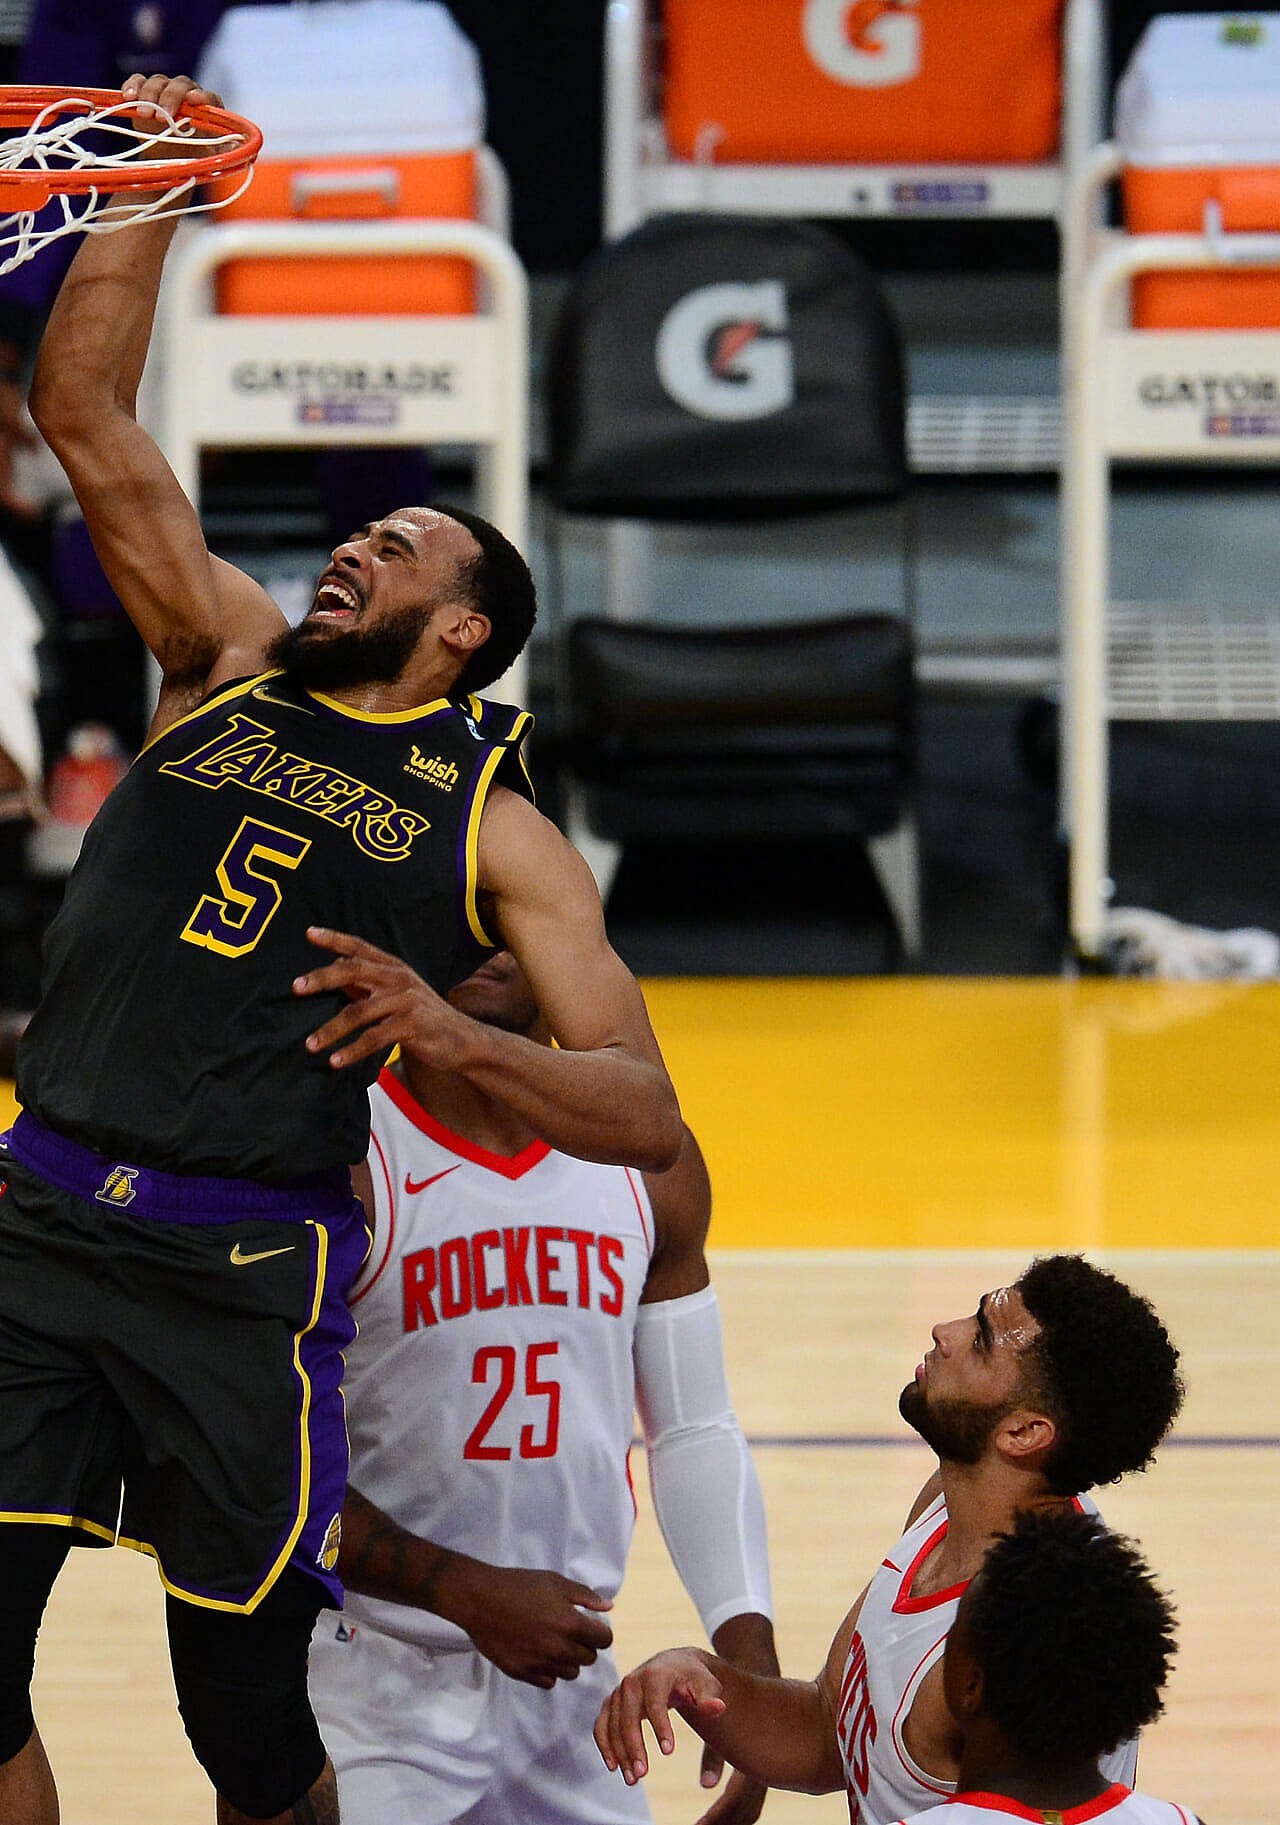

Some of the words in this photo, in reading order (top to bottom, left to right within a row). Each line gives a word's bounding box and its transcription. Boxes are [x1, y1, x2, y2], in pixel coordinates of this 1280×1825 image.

[234, 362, 455, 395] GATORADE
[656, 278, 794, 422] G
[158, 713, 431, 862] LAKERS
[403, 764, 453, 792] SHOPPING
[410, 744, 459, 784] wish
[180, 815, 312, 959] 5
[402, 1226, 624, 1333] ROCKETS
[463, 1341, 561, 1461] 25
